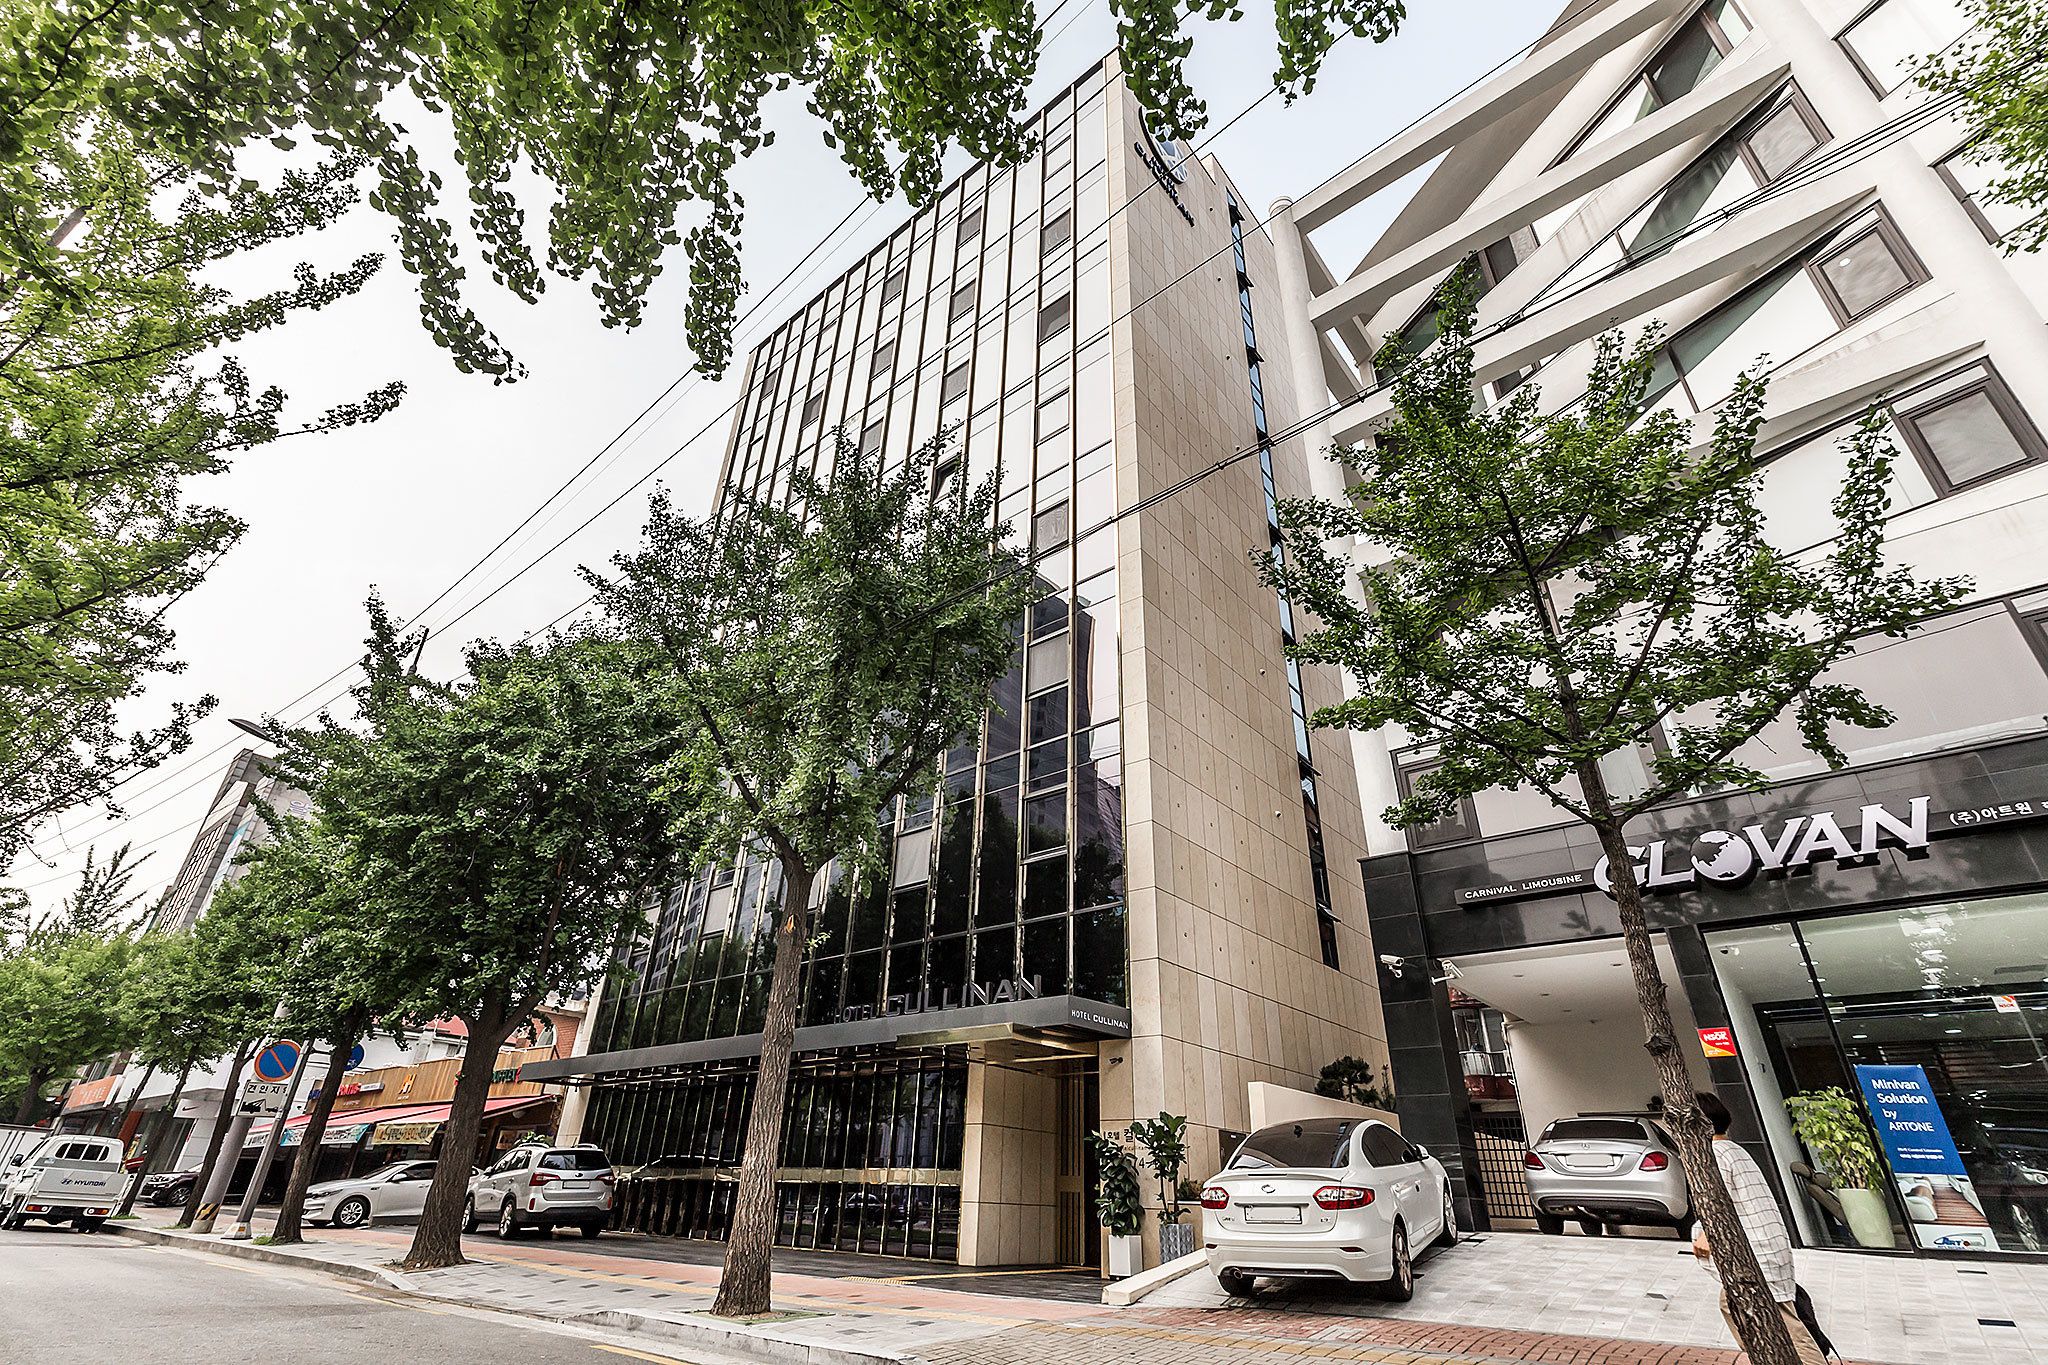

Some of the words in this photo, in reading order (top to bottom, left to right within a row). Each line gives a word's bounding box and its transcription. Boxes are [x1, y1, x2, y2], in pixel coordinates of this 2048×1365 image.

[1949, 801, 2033, 826] (주)아트원
[1464, 885, 1517, 899] CARNIVAL
[1522, 874, 1583, 890] LIMOUSINE
[834, 1003, 877, 1024] HOTEL
[886, 974, 1042, 1017] CULLINAN
[1071, 1009, 1091, 1021] HOTEL
[1093, 1014, 1129, 1030] CULLINAN
[1871, 1079, 1920, 1090] Minivan
[1876, 1092, 1929, 1105] Solution
[1882, 1108, 1897, 1120] by
[1889, 1121, 1935, 1132] ARTONE
